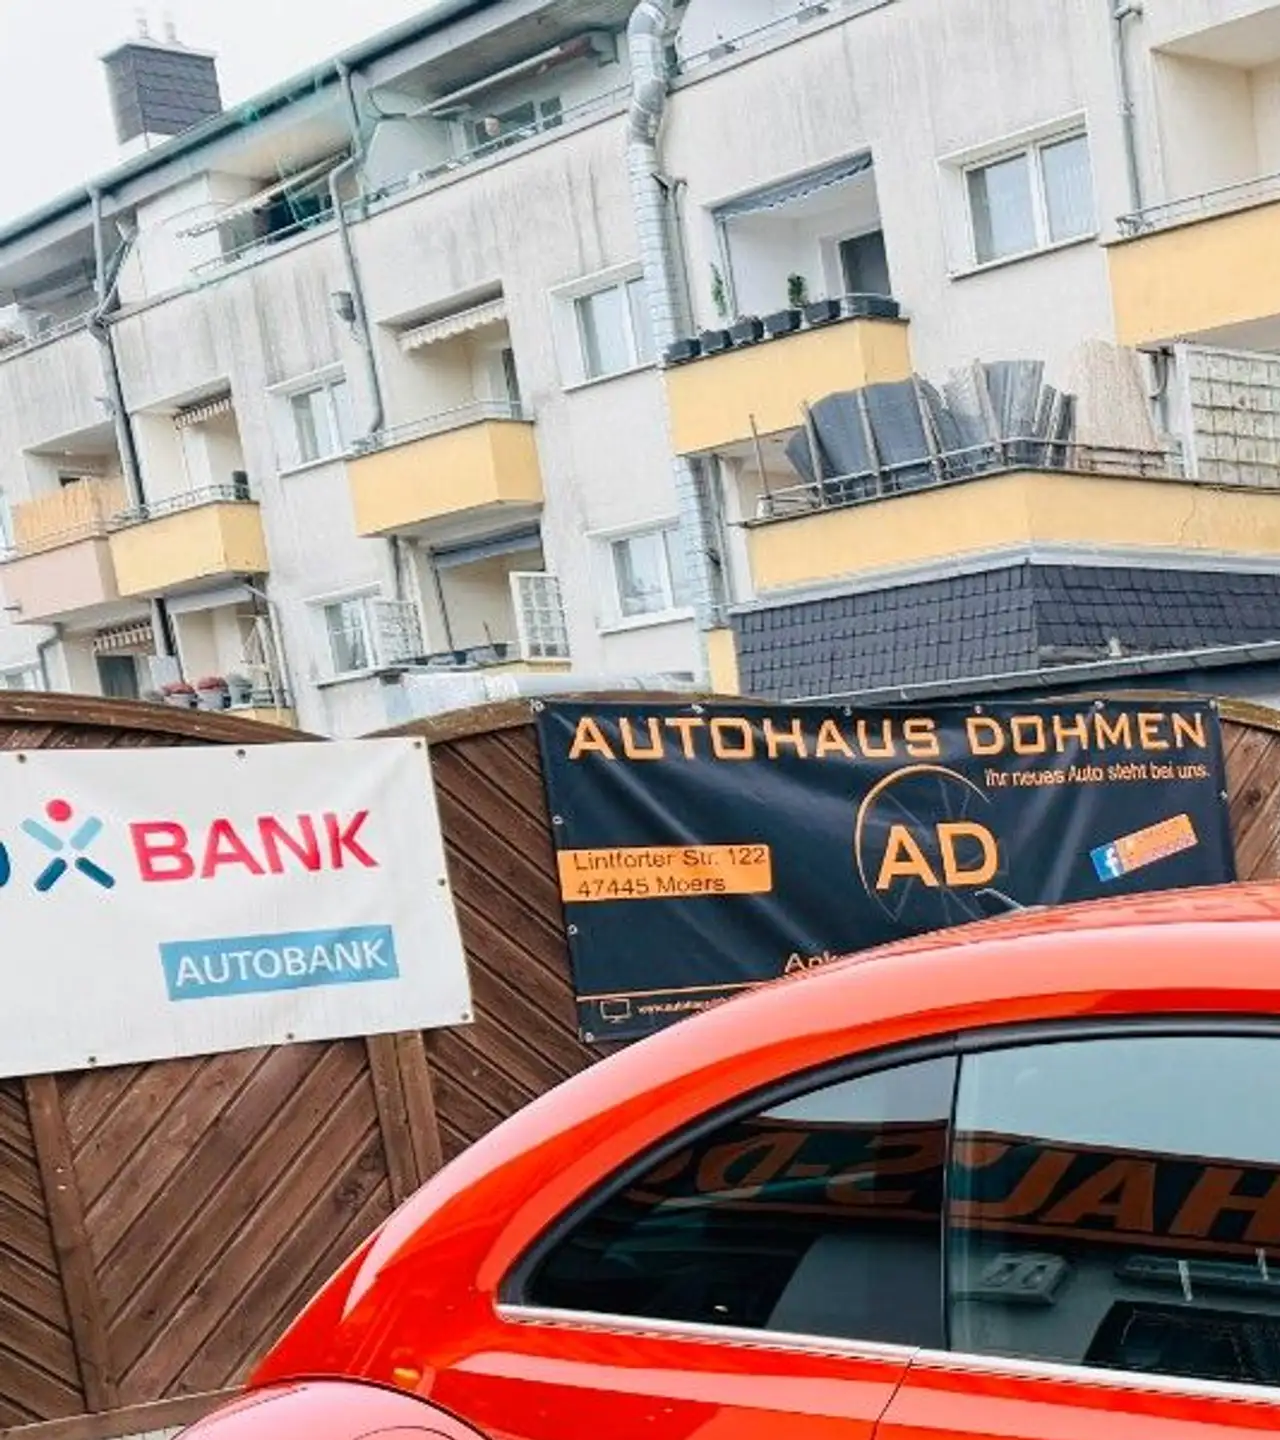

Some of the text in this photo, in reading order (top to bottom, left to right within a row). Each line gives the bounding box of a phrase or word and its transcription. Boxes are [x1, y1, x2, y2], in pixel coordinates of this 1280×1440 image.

[569, 711, 1208, 760] AUTOHAUS DOHMEN
[1013, 769, 1066, 787] neues
[1068, 765, 1104, 783] Auto
[1108, 763, 1147, 781] steht
[1149, 761, 1174, 779] bei
[1178, 763, 1210, 779] uns.
[129, 810, 379, 882] BANK
[683, 848, 719, 866] Str.
[729, 847, 767, 866] 122
[876, 822, 999, 890] AD
[577, 875, 726, 898] 47445 Moers
[175, 937, 388, 987] AUTOBANK
